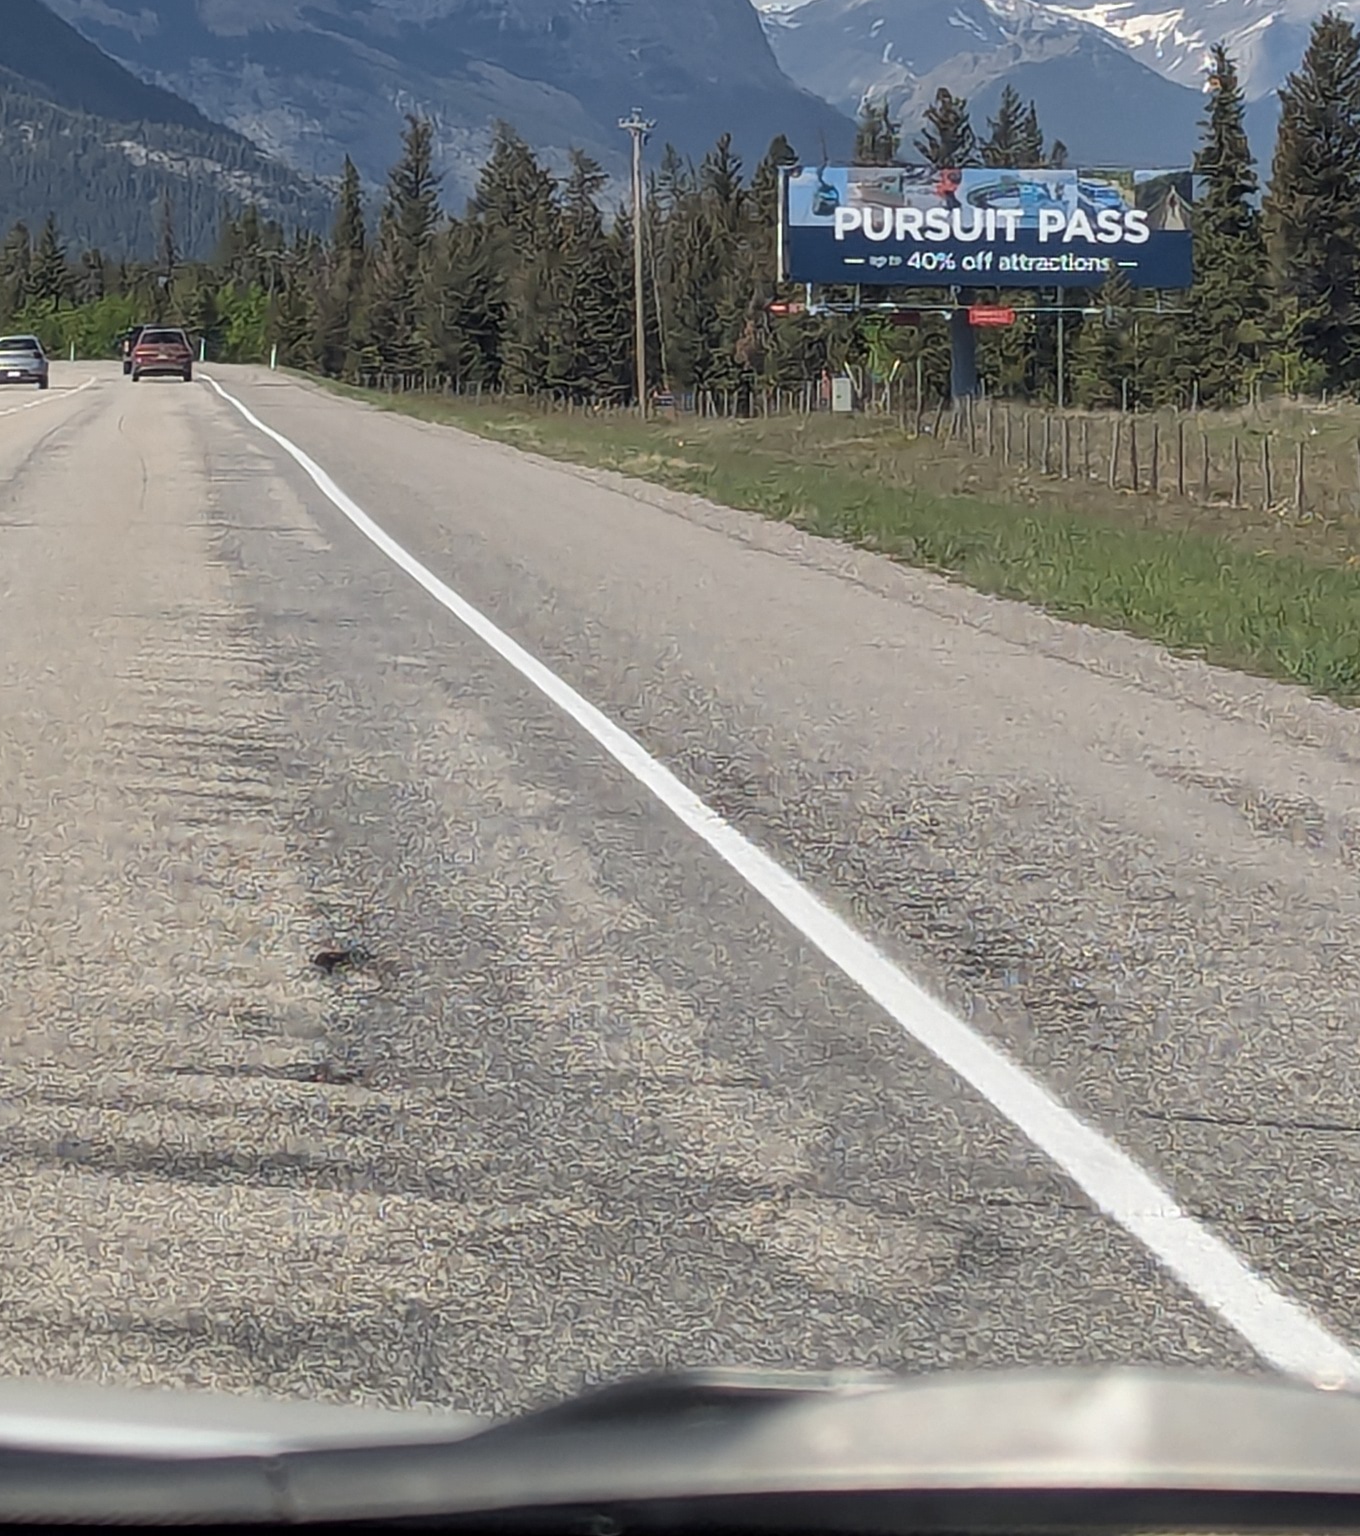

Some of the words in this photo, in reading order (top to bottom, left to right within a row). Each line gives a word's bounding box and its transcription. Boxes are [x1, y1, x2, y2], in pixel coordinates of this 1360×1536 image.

[834, 206, 1025, 242] PURSUIT
[1038, 208, 1151, 244] PASS
[907, 251, 957, 270] 40%
[961, 251, 994, 270] off
[998, 252, 1111, 272] attractions
